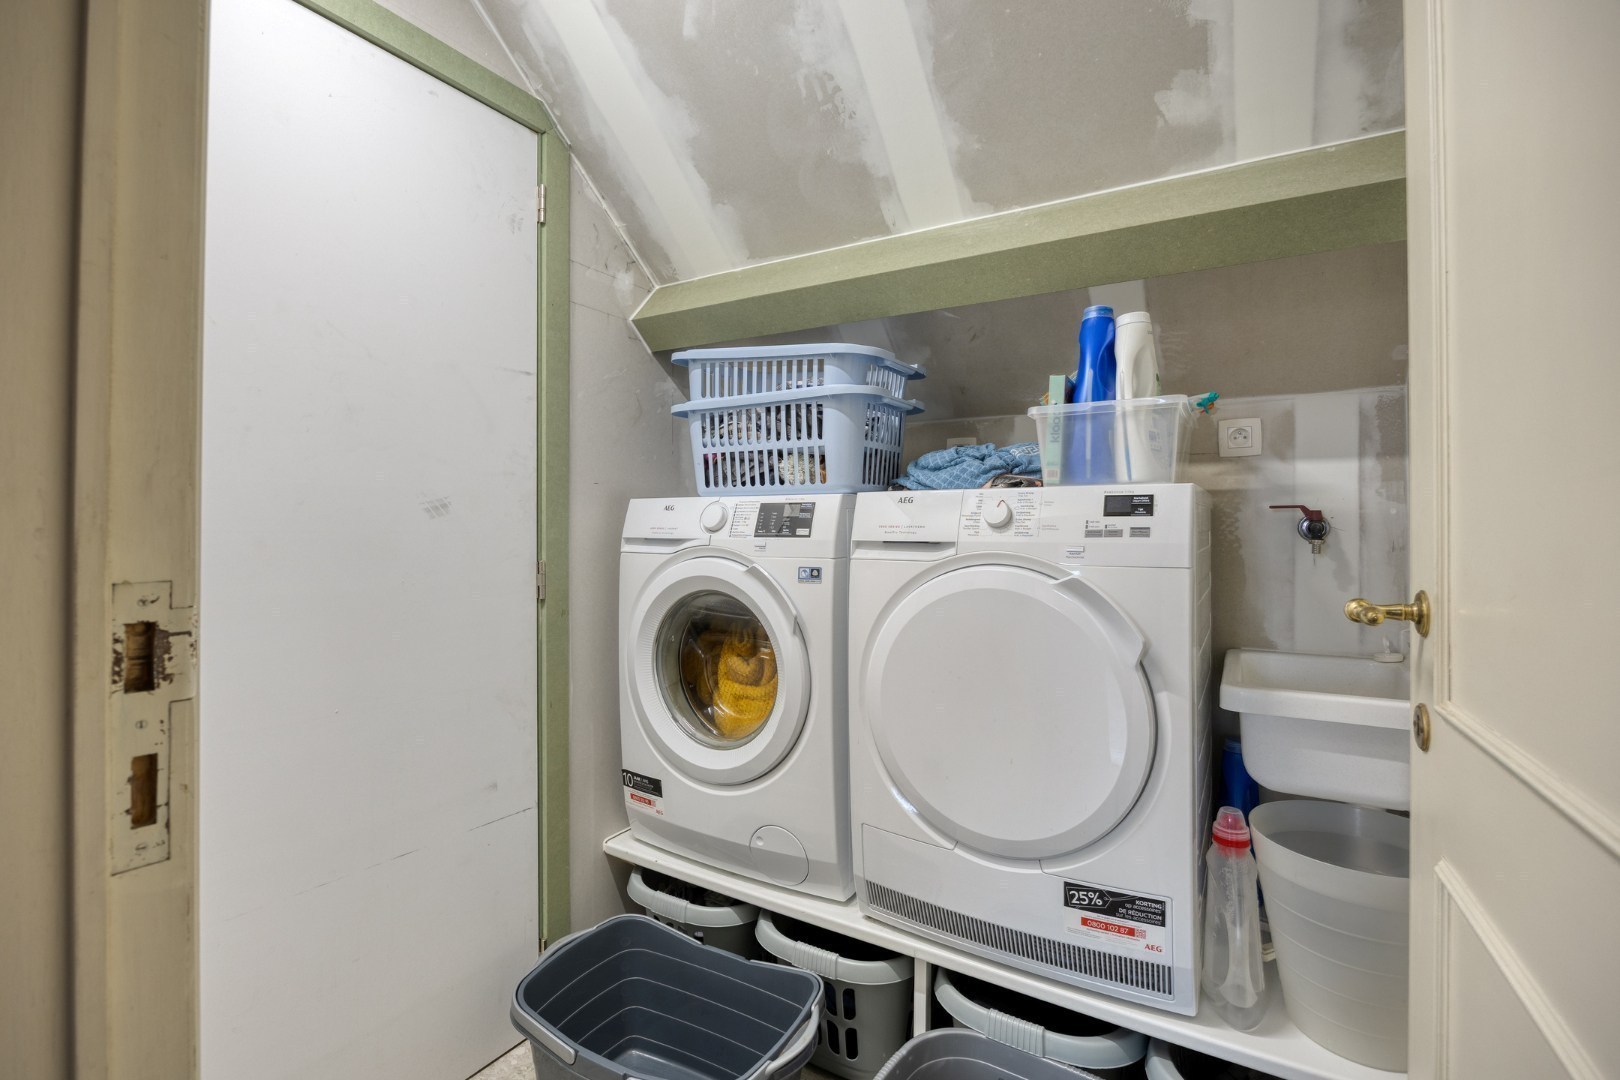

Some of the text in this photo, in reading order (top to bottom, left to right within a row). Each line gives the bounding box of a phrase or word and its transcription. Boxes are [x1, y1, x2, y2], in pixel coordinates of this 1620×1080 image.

[897, 496, 914, 504] AEG
[622, 772, 634, 787] 10
[1069, 890, 1103, 906] 25%
[1135, 900, 1163, 909] KORTING
[1087, 920, 1106, 929] 0800
[1107, 924, 1119, 933] 102
[1144, 944, 1163, 953] AEG
